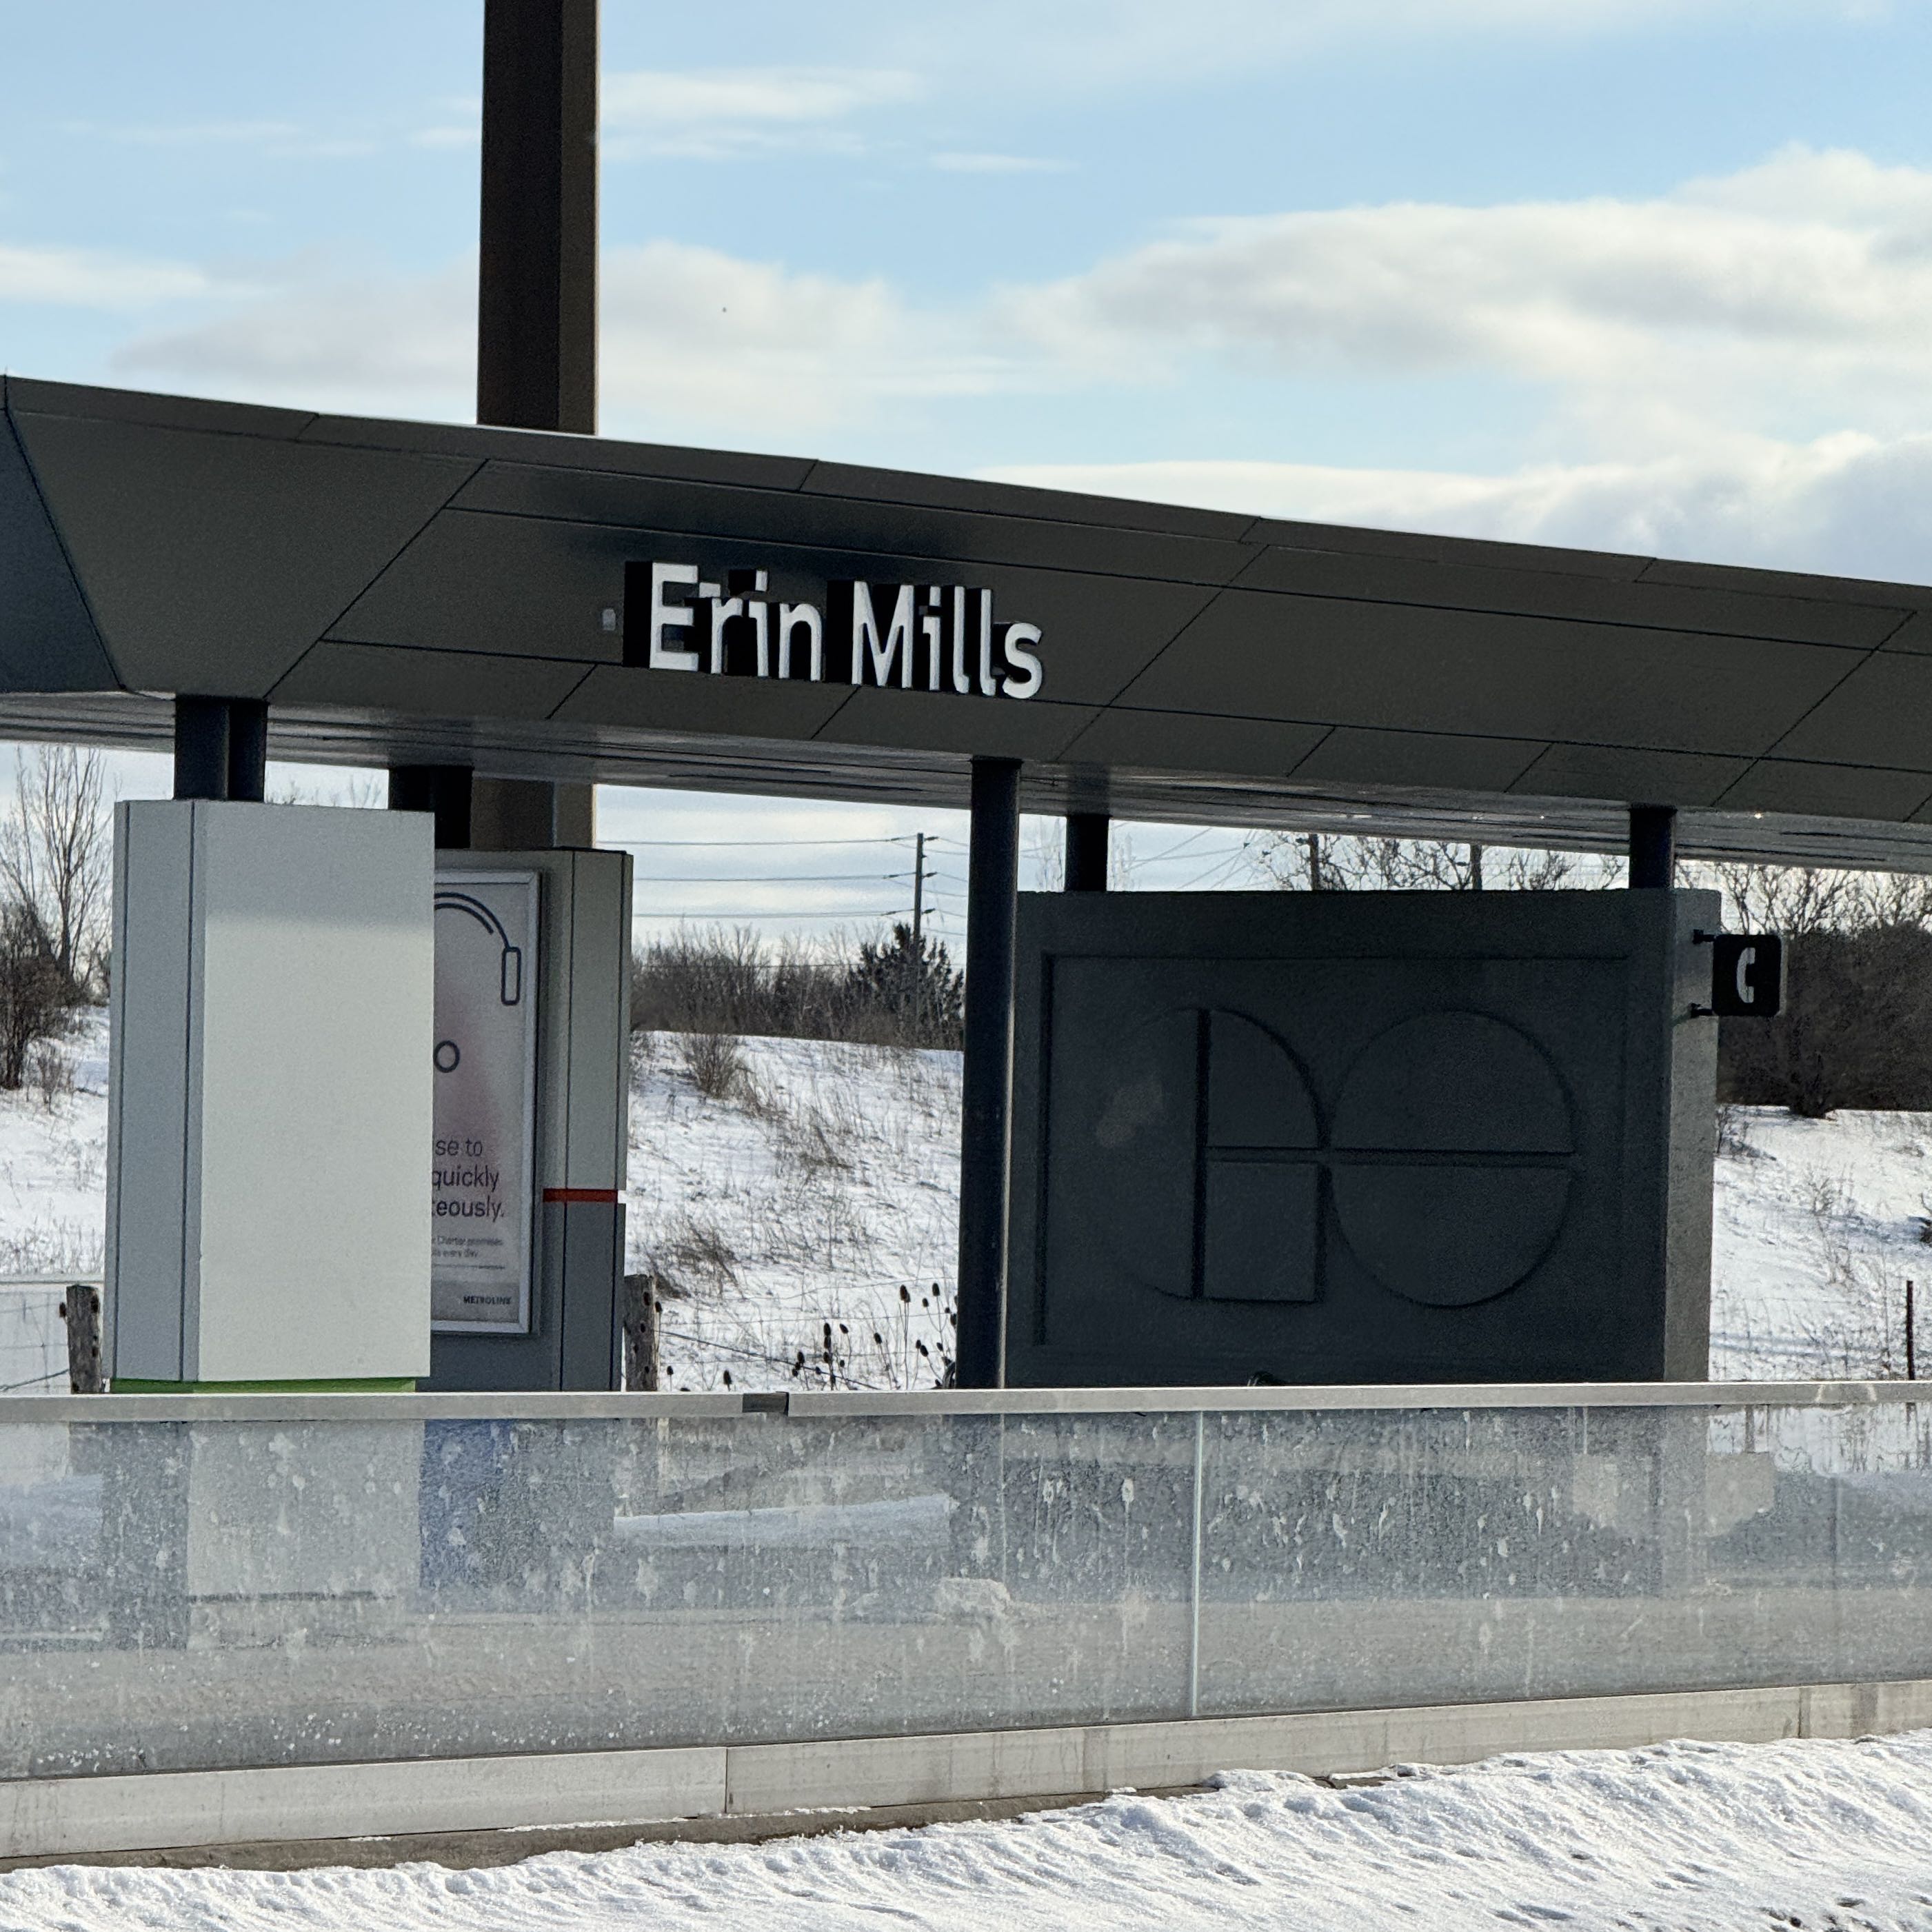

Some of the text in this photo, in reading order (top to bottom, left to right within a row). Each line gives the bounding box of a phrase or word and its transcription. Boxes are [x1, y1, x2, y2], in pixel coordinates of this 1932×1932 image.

[649, 561, 1044, 699] Erin Mills
[465, 1138, 483, 1157] to
[432, 1164, 499, 1193] quickly
